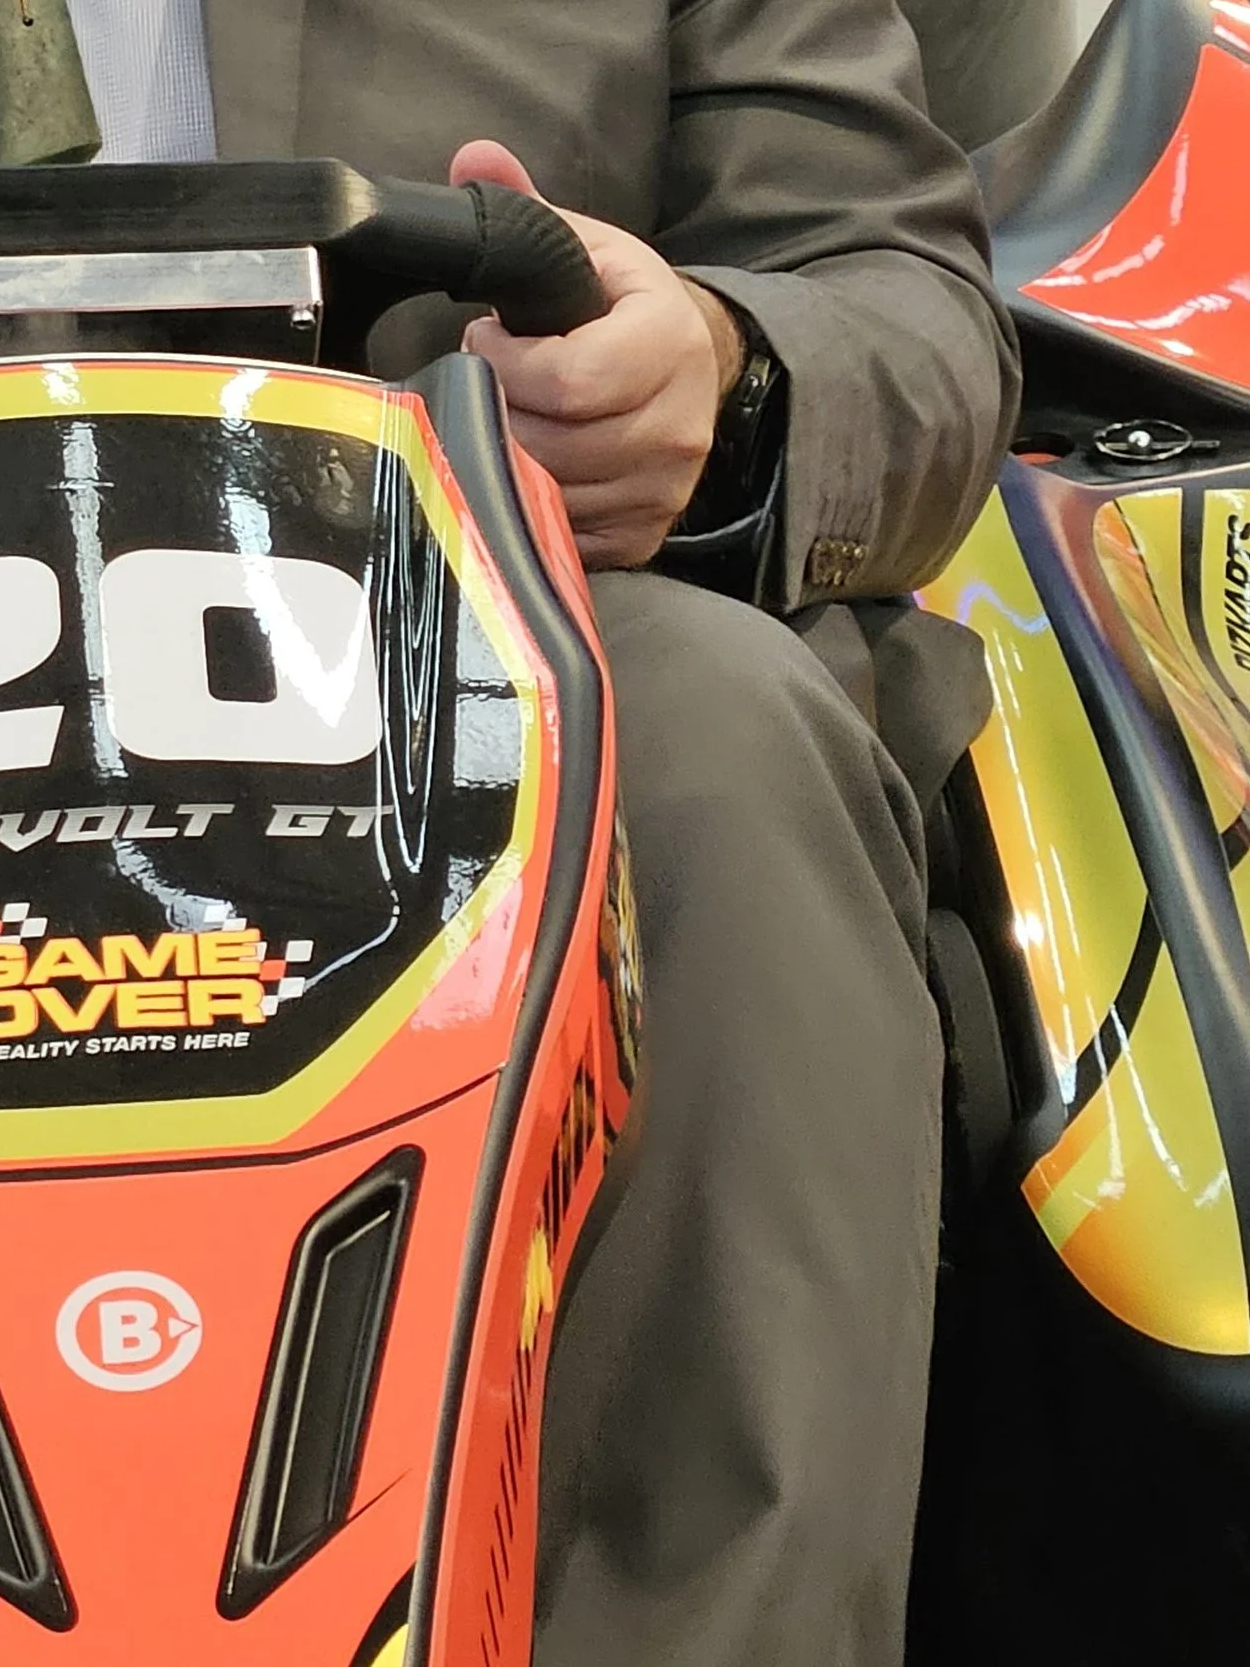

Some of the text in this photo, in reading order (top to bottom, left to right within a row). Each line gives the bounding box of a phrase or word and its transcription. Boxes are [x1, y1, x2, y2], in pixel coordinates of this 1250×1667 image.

[264, 803, 394, 839] GT
[84, 1034, 177, 1054] STARTS
[183, 1031, 251, 1052] HERE
[98, 1298, 162, 1366] B
